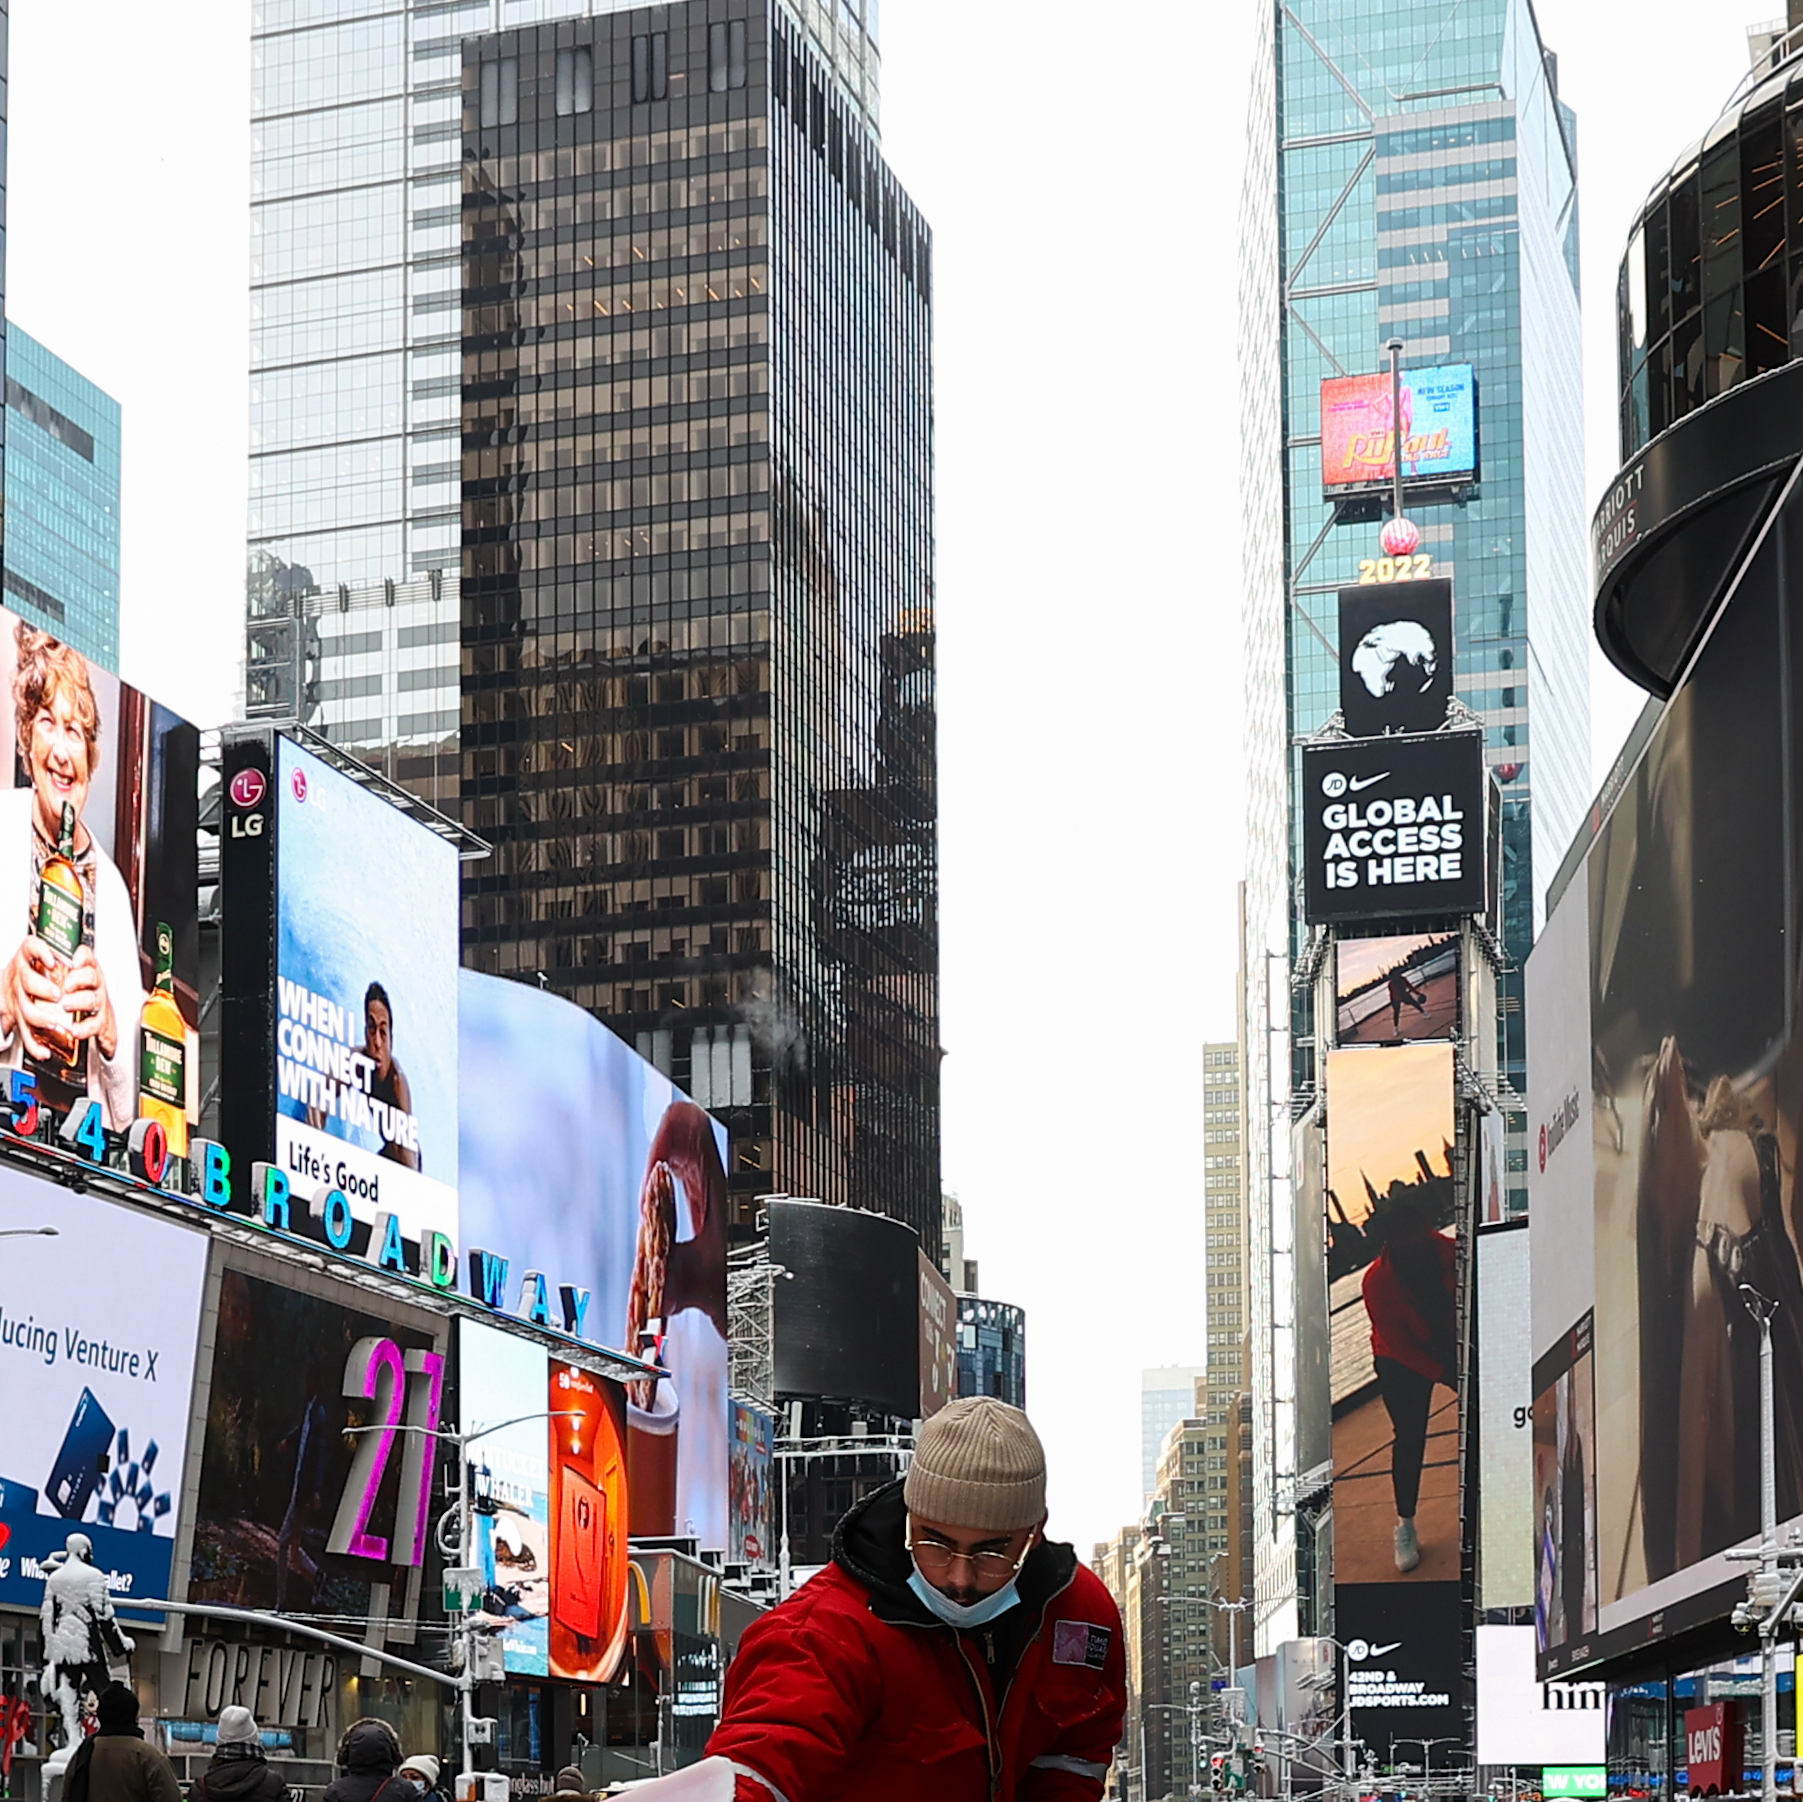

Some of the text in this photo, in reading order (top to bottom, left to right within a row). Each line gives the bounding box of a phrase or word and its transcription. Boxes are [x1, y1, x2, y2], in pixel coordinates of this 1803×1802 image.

[1358, 554, 1432, 585] 2022
[232, 814, 264, 838] LG
[1322, 794, 1463, 829] GLOBAL
[1323, 823, 1462, 860] ACCESS
[1325, 850, 1462, 889] IS HERE
[278, 976, 356, 1040] WHEN I
[278, 1013, 375, 1096] CONNECT
[277, 1059, 420, 1153] WITH NATURE
[289, 1141, 380, 1204] Life's Good
[65, 1326, 138, 1377] Venture
[142, 1348, 160, 1384] X
[327, 1338, 446, 1566] 21
[184, 1637, 338, 1728] FOREVER
[1348, 1671, 1396, 1683] 42ND &
[1348, 1682, 1426, 1696] BROADWAY
[1348, 1694, 1450, 1708] JDSPORTS.COM
